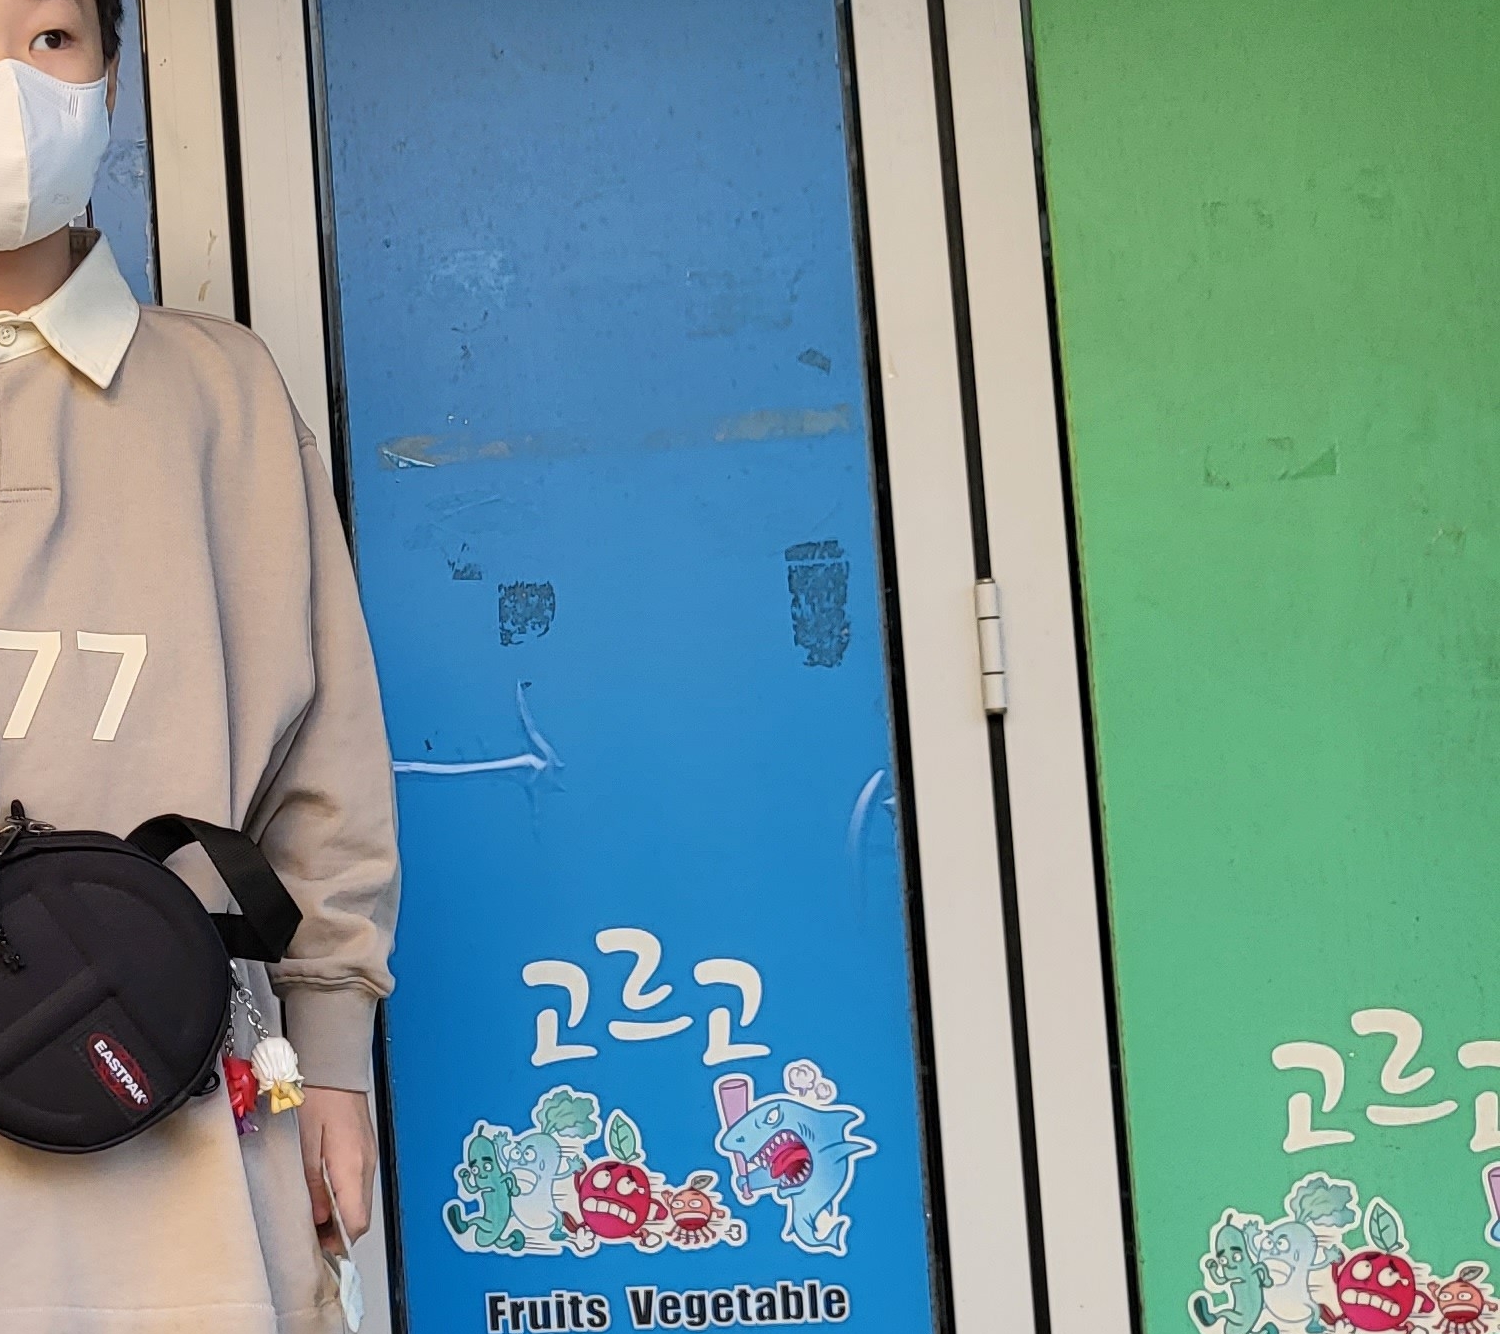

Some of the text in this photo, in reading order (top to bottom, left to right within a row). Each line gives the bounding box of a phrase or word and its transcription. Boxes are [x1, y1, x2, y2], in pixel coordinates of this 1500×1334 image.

[521, 928, 772, 1067] 고르고
[93, 1039, 148, 1106] EASTPAK
[488, 1282, 848, 1333] Fruits Vegetable
